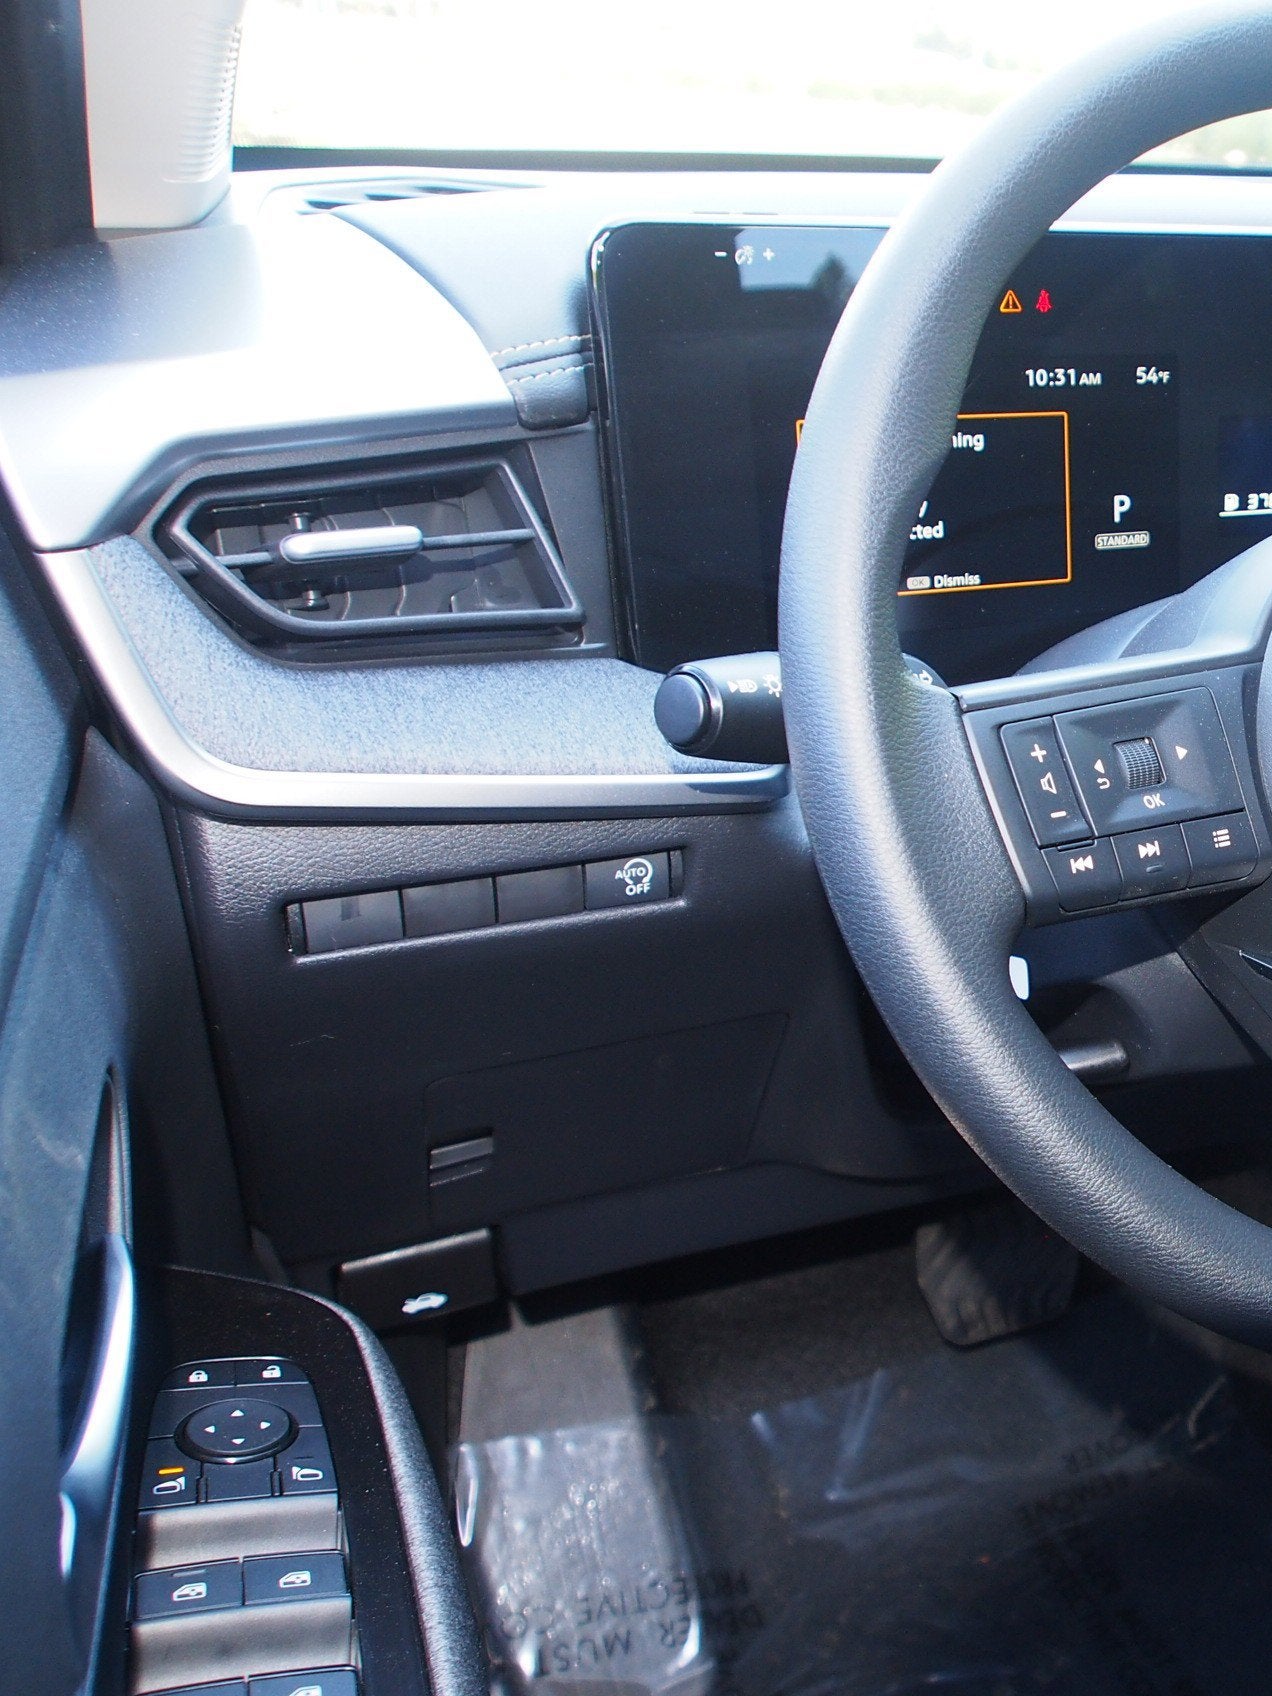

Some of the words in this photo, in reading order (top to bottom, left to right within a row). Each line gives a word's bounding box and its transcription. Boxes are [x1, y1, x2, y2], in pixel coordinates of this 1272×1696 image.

[1025, 368, 1076, 388] 10:31
[1079, 371, 1102, 386] AM
[1136, 366, 1170, 385] 54°F
[1113, 495, 1132, 523] P
[1097, 533, 1149, 547] STANDARD
[934, 573, 981, 589] Dismiss
[1143, 793, 1166, 809] OK
[615, 867, 646, 880] AUTO
[625, 883, 651, 896] OFF
